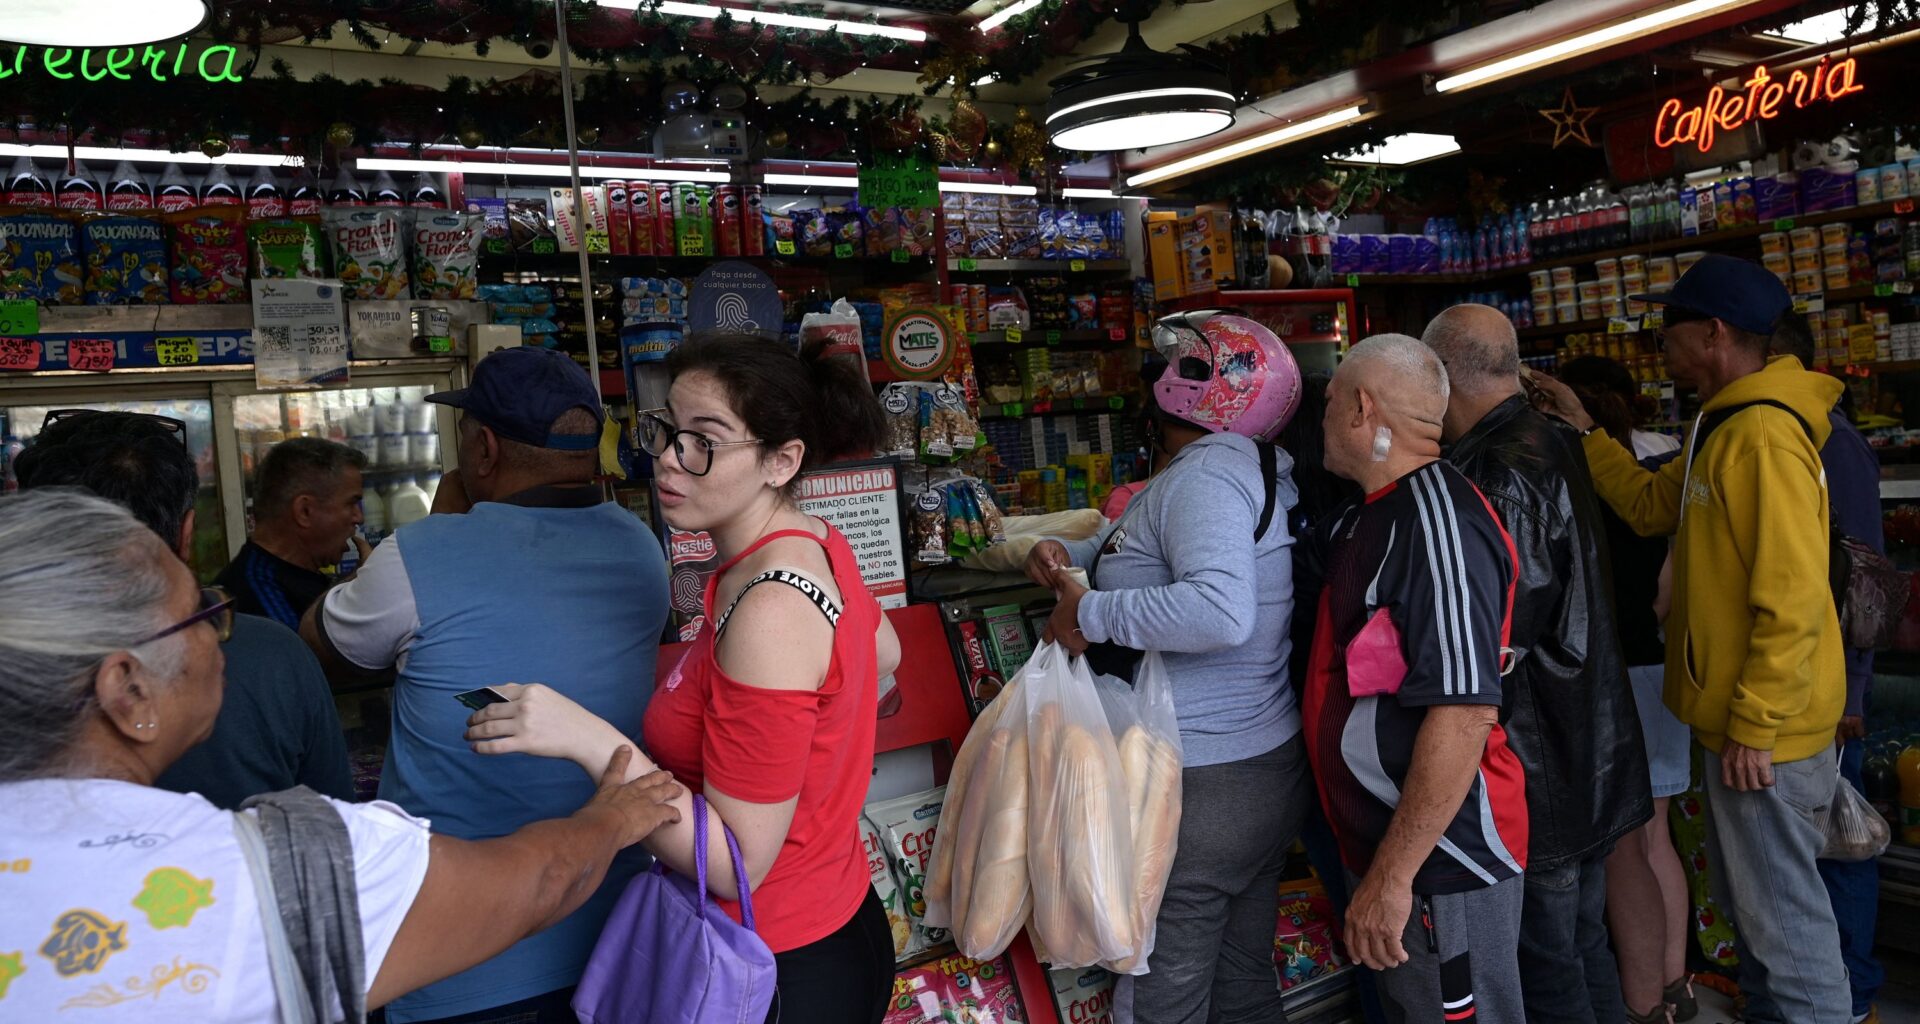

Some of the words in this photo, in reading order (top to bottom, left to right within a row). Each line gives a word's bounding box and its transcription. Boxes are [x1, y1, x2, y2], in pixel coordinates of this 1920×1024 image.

[1655, 57, 1864, 152] Cafeteria
[899, 332, 939, 350] MATIS
[801, 471, 893, 497] OMUNICADO
[836, 508, 858, 519] fallas
[872, 507, 880, 515] la
[846, 515, 890, 530] tecnológica
[861, 539, 889, 550] quedan
[858, 549, 892, 560] nuestros
[779, 571, 820, 600] LOVE
[820, 597, 841, 627] OVE
[902, 827, 938, 857] Cro
[940, 957, 975, 976] fru
